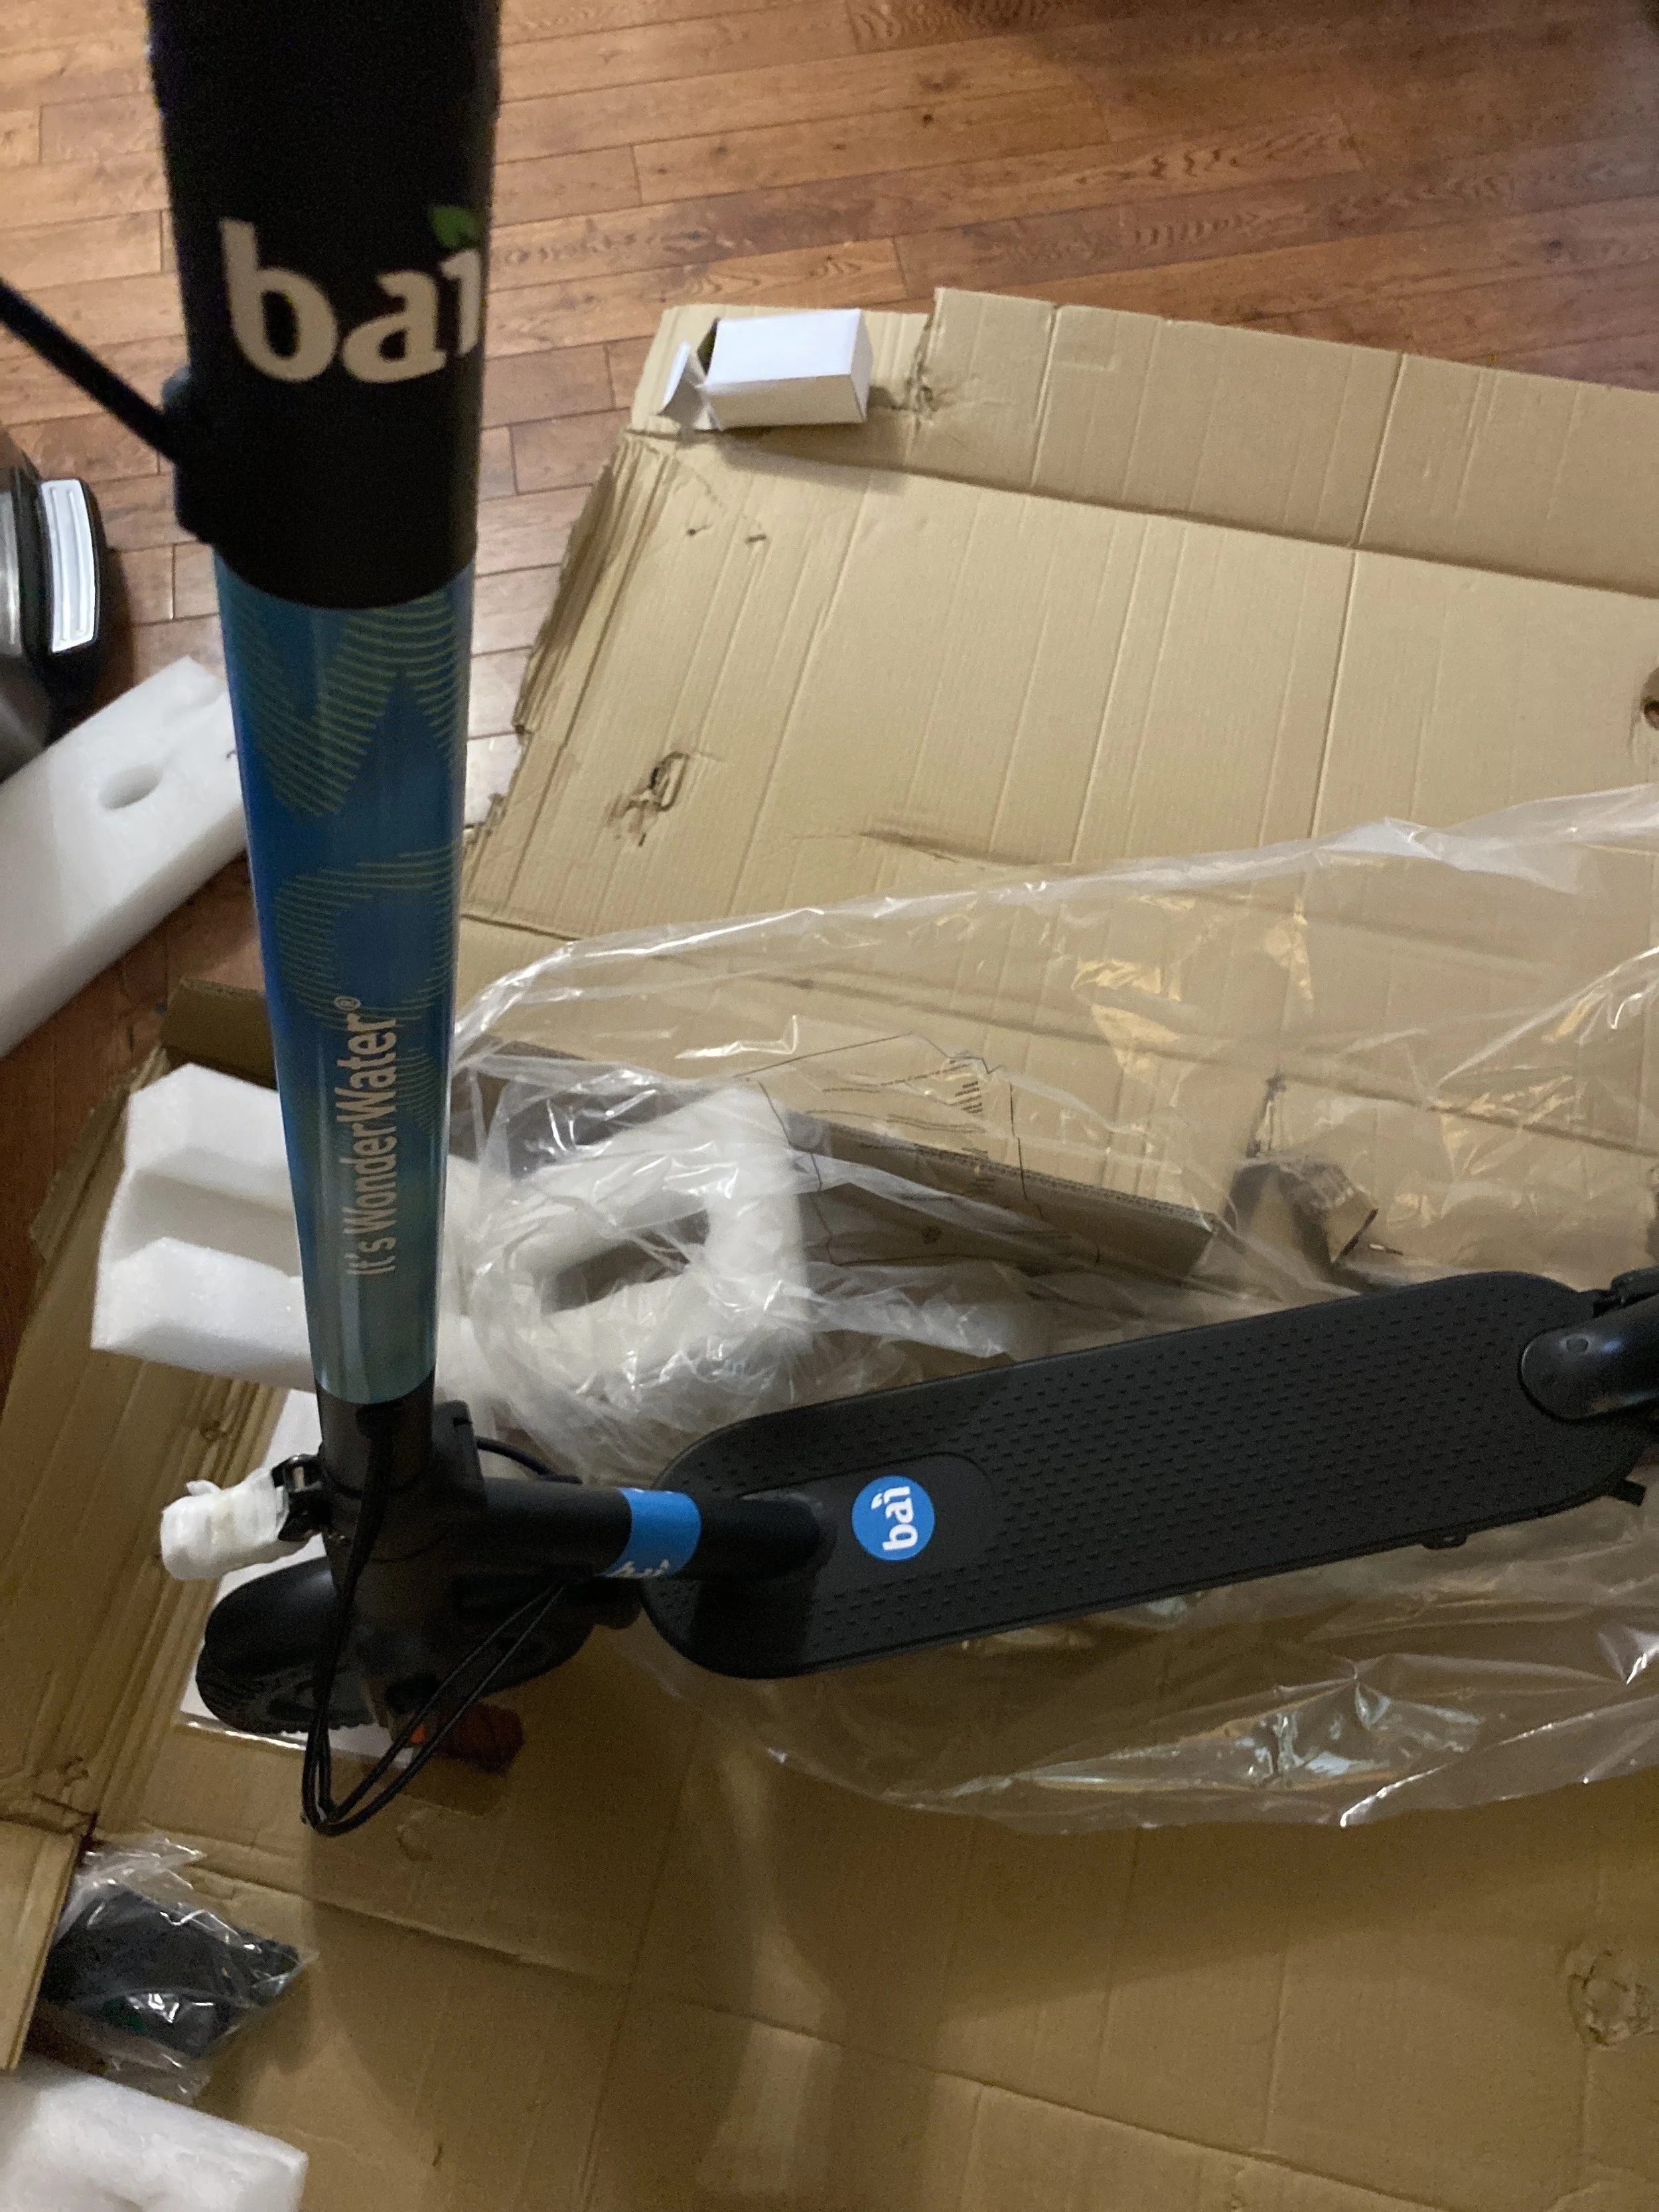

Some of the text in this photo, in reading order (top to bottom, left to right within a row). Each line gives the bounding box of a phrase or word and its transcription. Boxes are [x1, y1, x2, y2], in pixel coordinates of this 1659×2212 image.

[218, 206, 483, 383] bai
[346, 1236, 397, 1276] It's
[871, 1486, 918, 1551] bai
